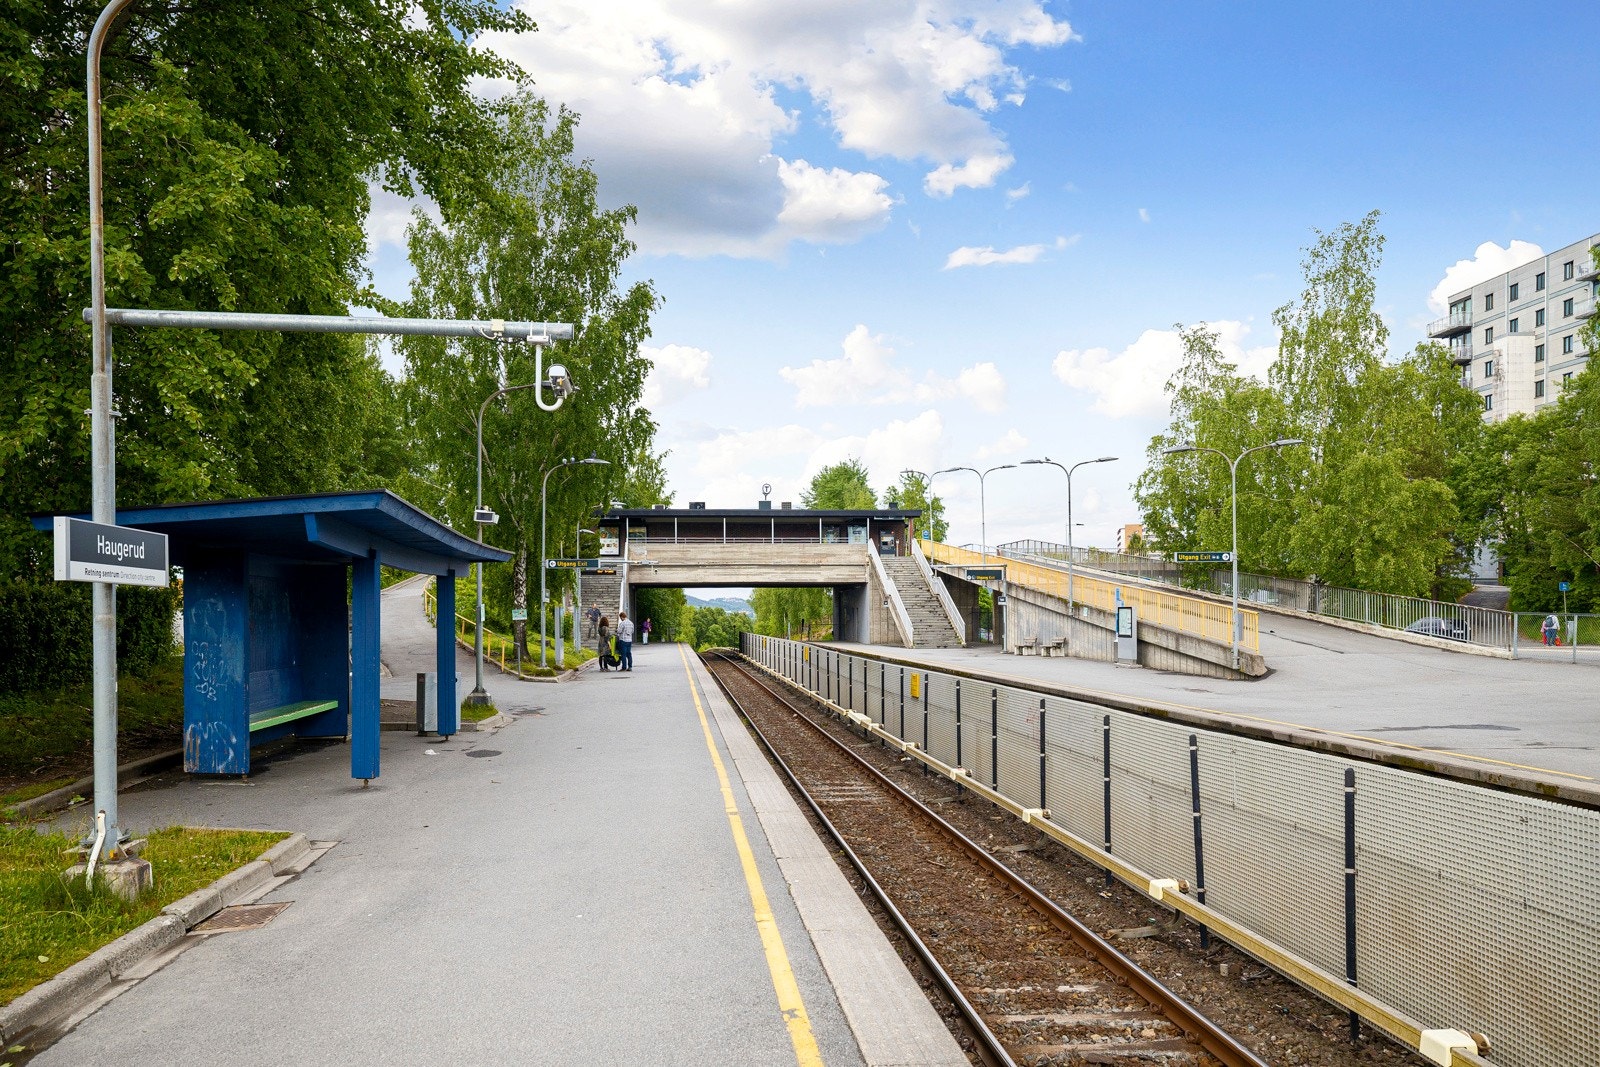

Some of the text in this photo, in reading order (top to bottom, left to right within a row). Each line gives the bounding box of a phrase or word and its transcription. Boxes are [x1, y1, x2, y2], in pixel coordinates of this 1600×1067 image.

[97, 534, 145, 561] Haugerud
[85, 567, 101, 578] Retning
[102, 570, 120, 578] sentrum
